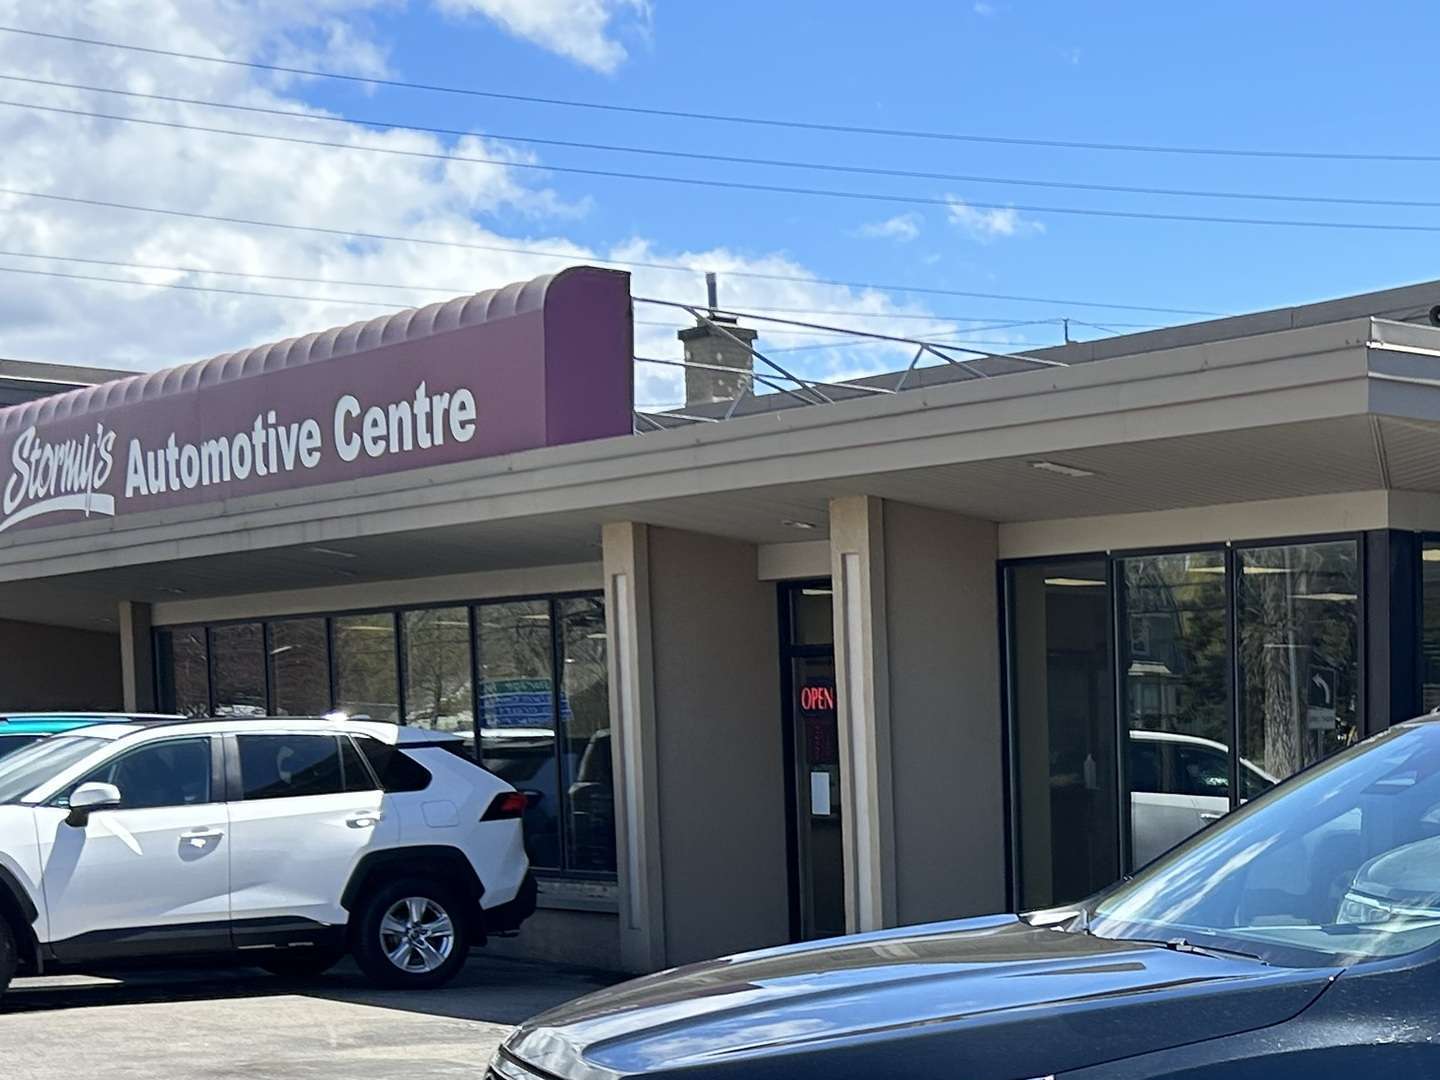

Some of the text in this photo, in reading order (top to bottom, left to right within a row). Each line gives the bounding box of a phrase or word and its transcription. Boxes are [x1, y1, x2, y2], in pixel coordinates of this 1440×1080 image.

[2, 380, 478, 518] Stormy's Automotive Centre
[801, 687, 834, 710] OPEN
